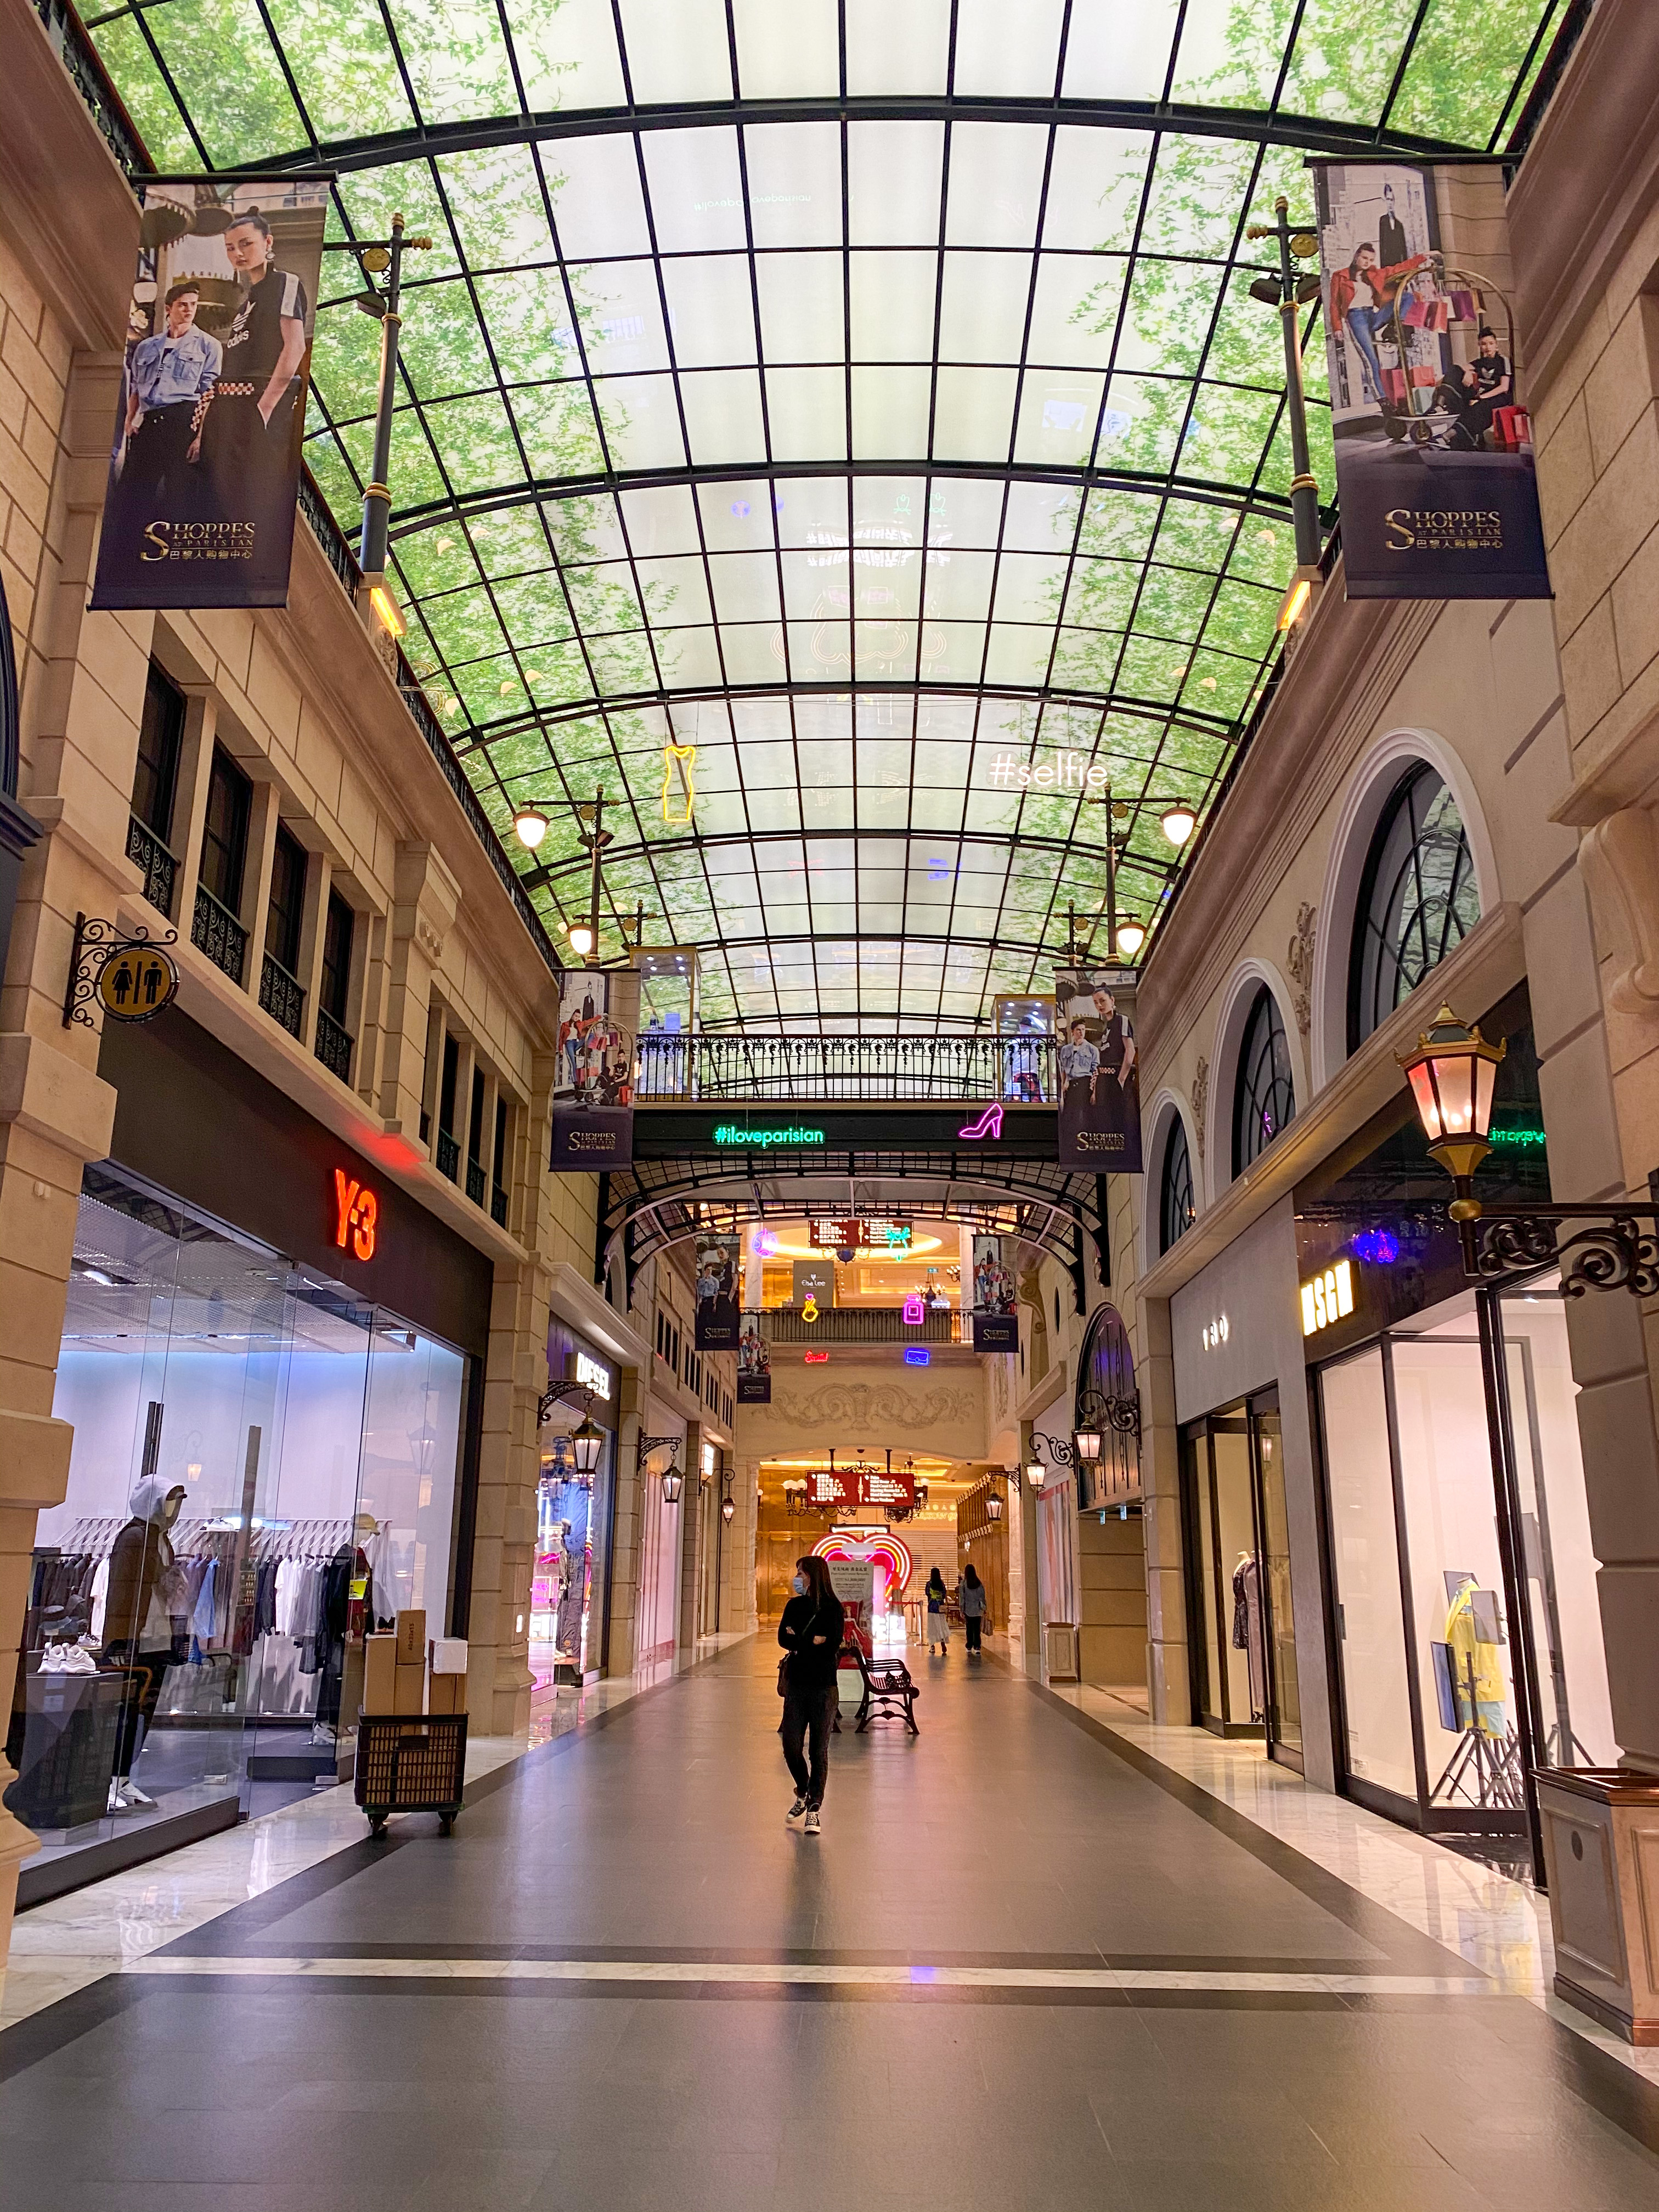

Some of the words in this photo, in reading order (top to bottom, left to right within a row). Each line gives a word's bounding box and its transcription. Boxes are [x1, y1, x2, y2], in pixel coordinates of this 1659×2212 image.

[140, 521, 255, 561] SHOPPES
[1385, 509, 1501, 550] SHOPPES
[989, 751, 1108, 786] #selfie
[568, 1131, 616, 1151] SHOPPES
[715, 1126, 823, 1148] #iloveparisian
[1076, 1131, 1125, 1151] SHOPPES
[335, 1169, 377, 1261] Y-3
[576, 1352, 610, 1401] DIESEL
